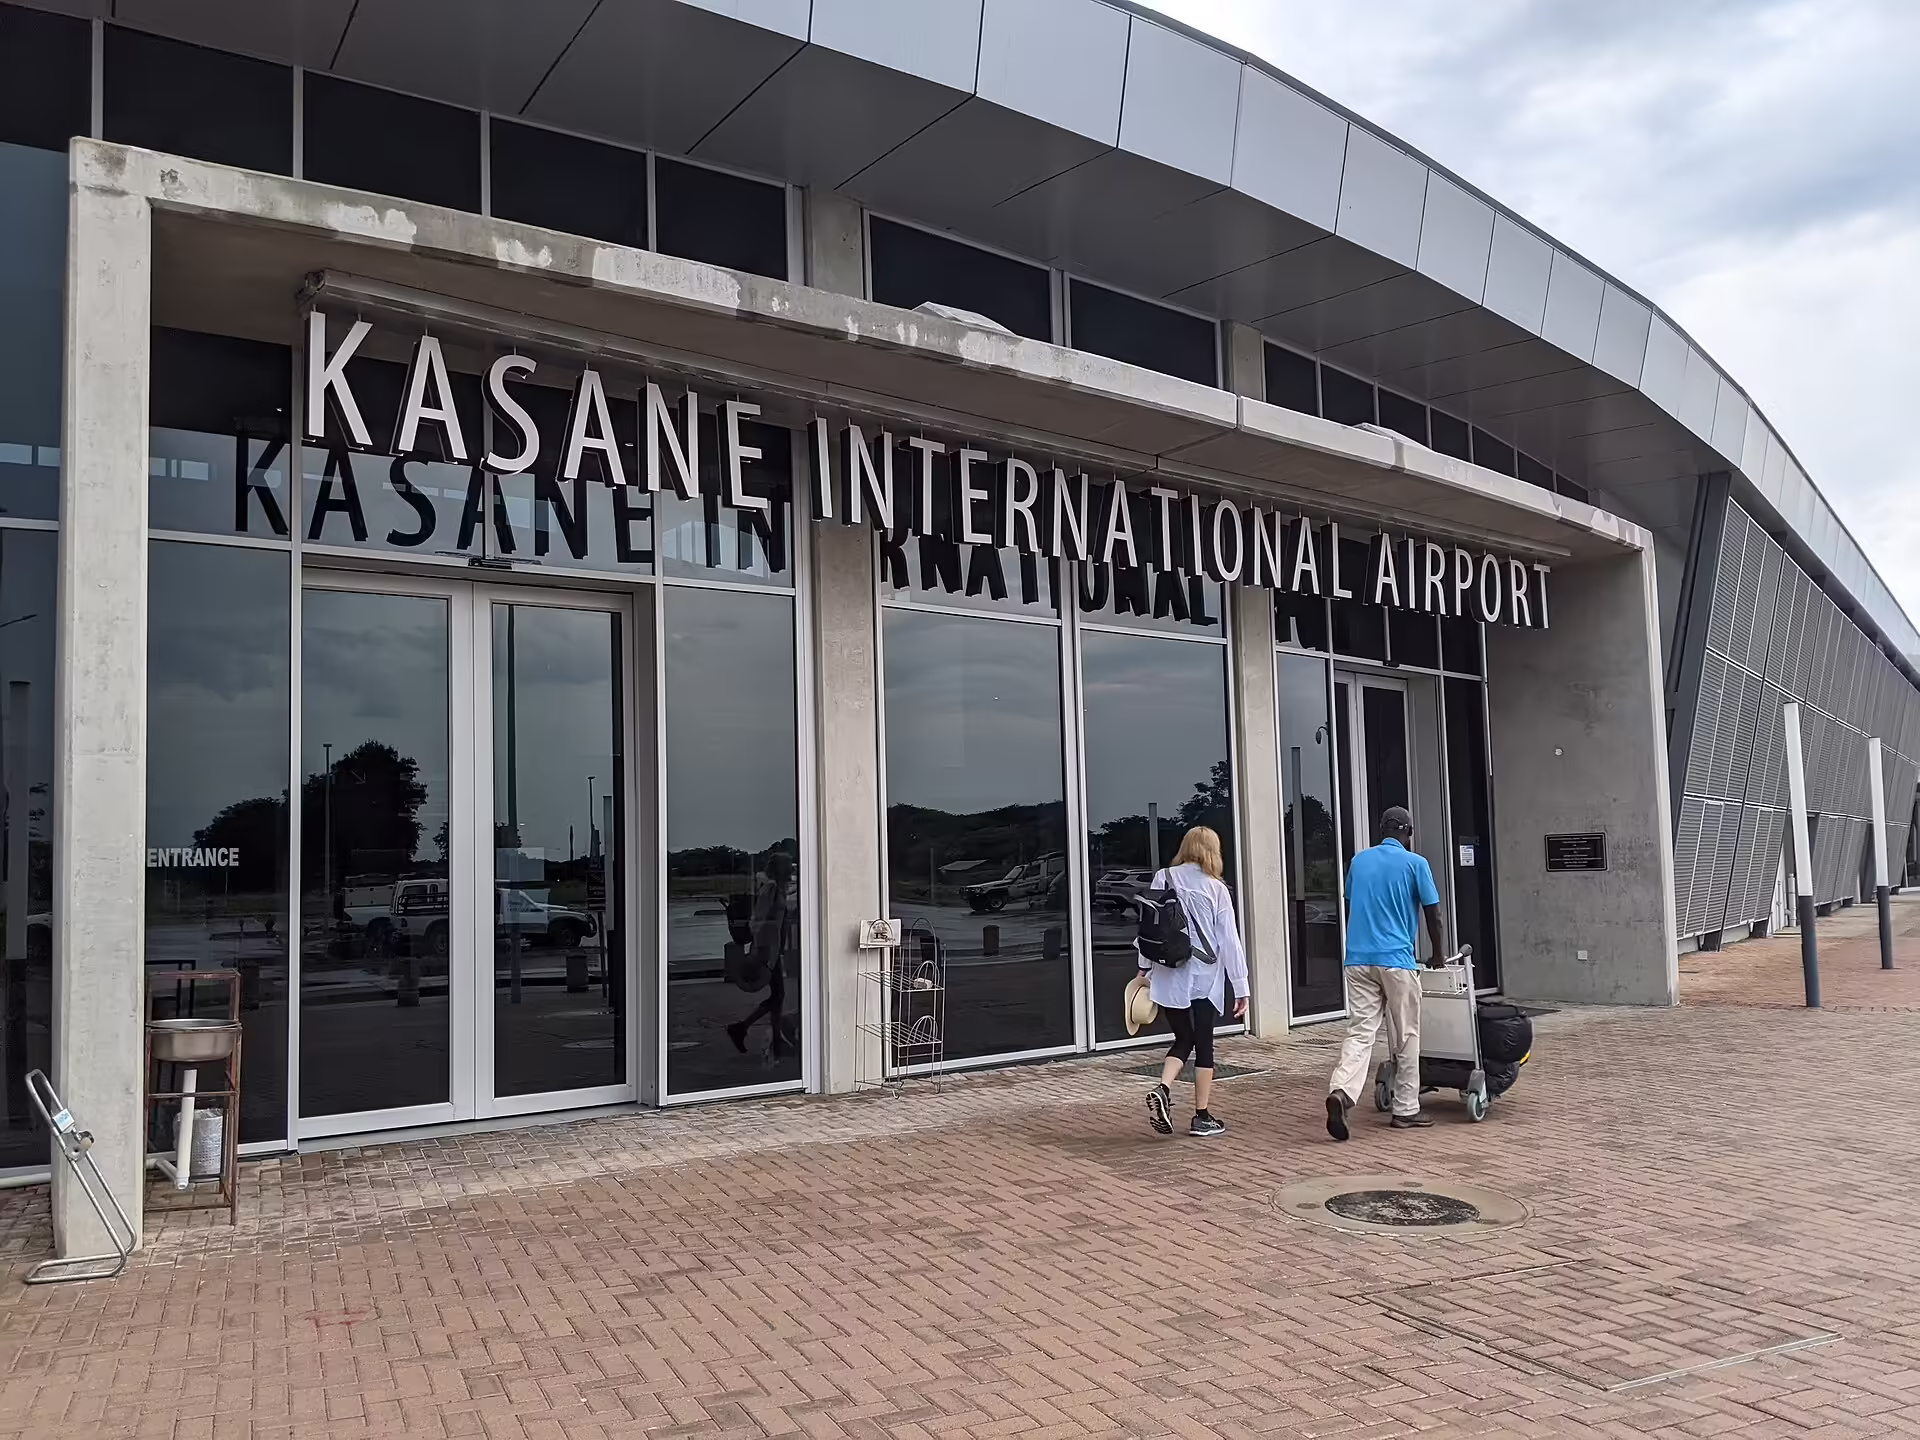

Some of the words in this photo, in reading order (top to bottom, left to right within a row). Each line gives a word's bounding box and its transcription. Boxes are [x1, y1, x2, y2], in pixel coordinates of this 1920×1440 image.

[307, 310, 769, 511] KASANE
[813, 417, 1353, 600] INTERNATIONAL
[1376, 532, 1551, 630] AIRPORT
[147, 847, 240, 868] ENTRANCE
